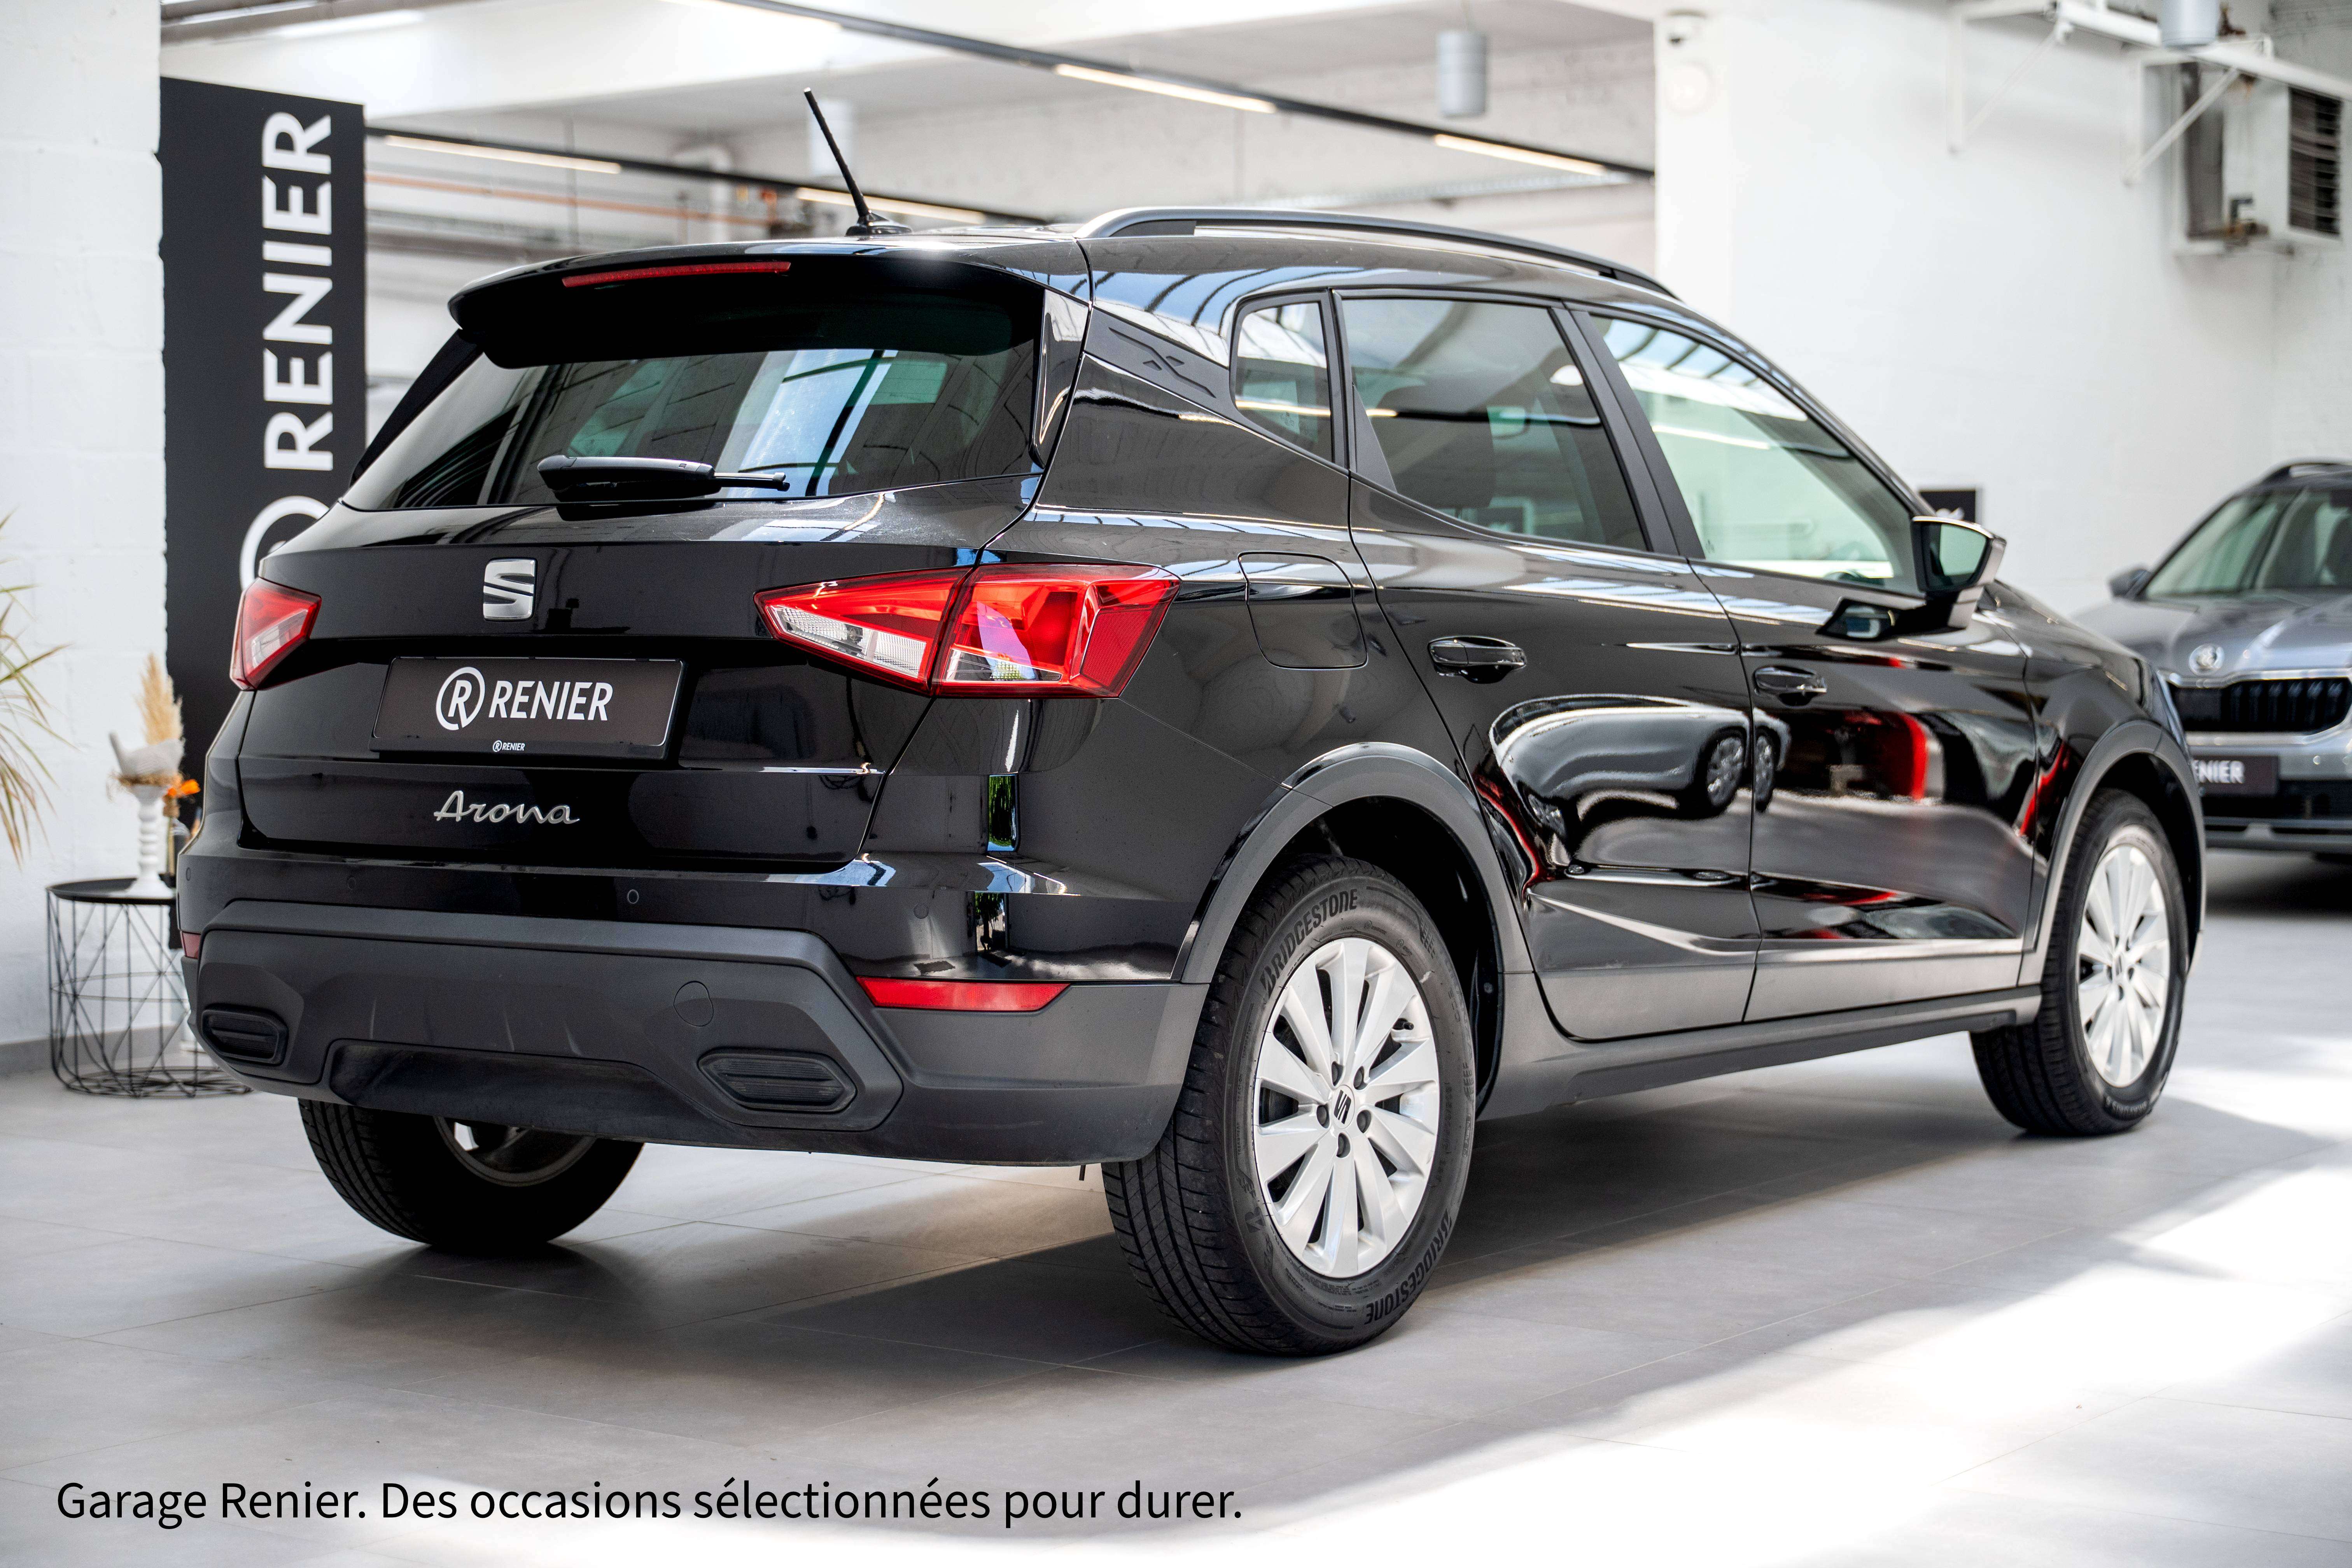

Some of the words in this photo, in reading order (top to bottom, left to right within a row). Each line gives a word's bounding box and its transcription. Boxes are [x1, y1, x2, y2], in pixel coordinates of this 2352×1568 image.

[262, 112, 333, 471] RENIER
[488, 680, 613, 721] RENIER
[502, 742, 525, 751] RENIER
[2192, 760, 2245, 784] ENIER
[433, 789, 580, 824] Arona
[1260, 888, 1358, 999] BRIDGESTONE
[1449, 988, 1460, 1022] ECO
[1364, 1208, 1452, 1325] BRIDGESTONE
